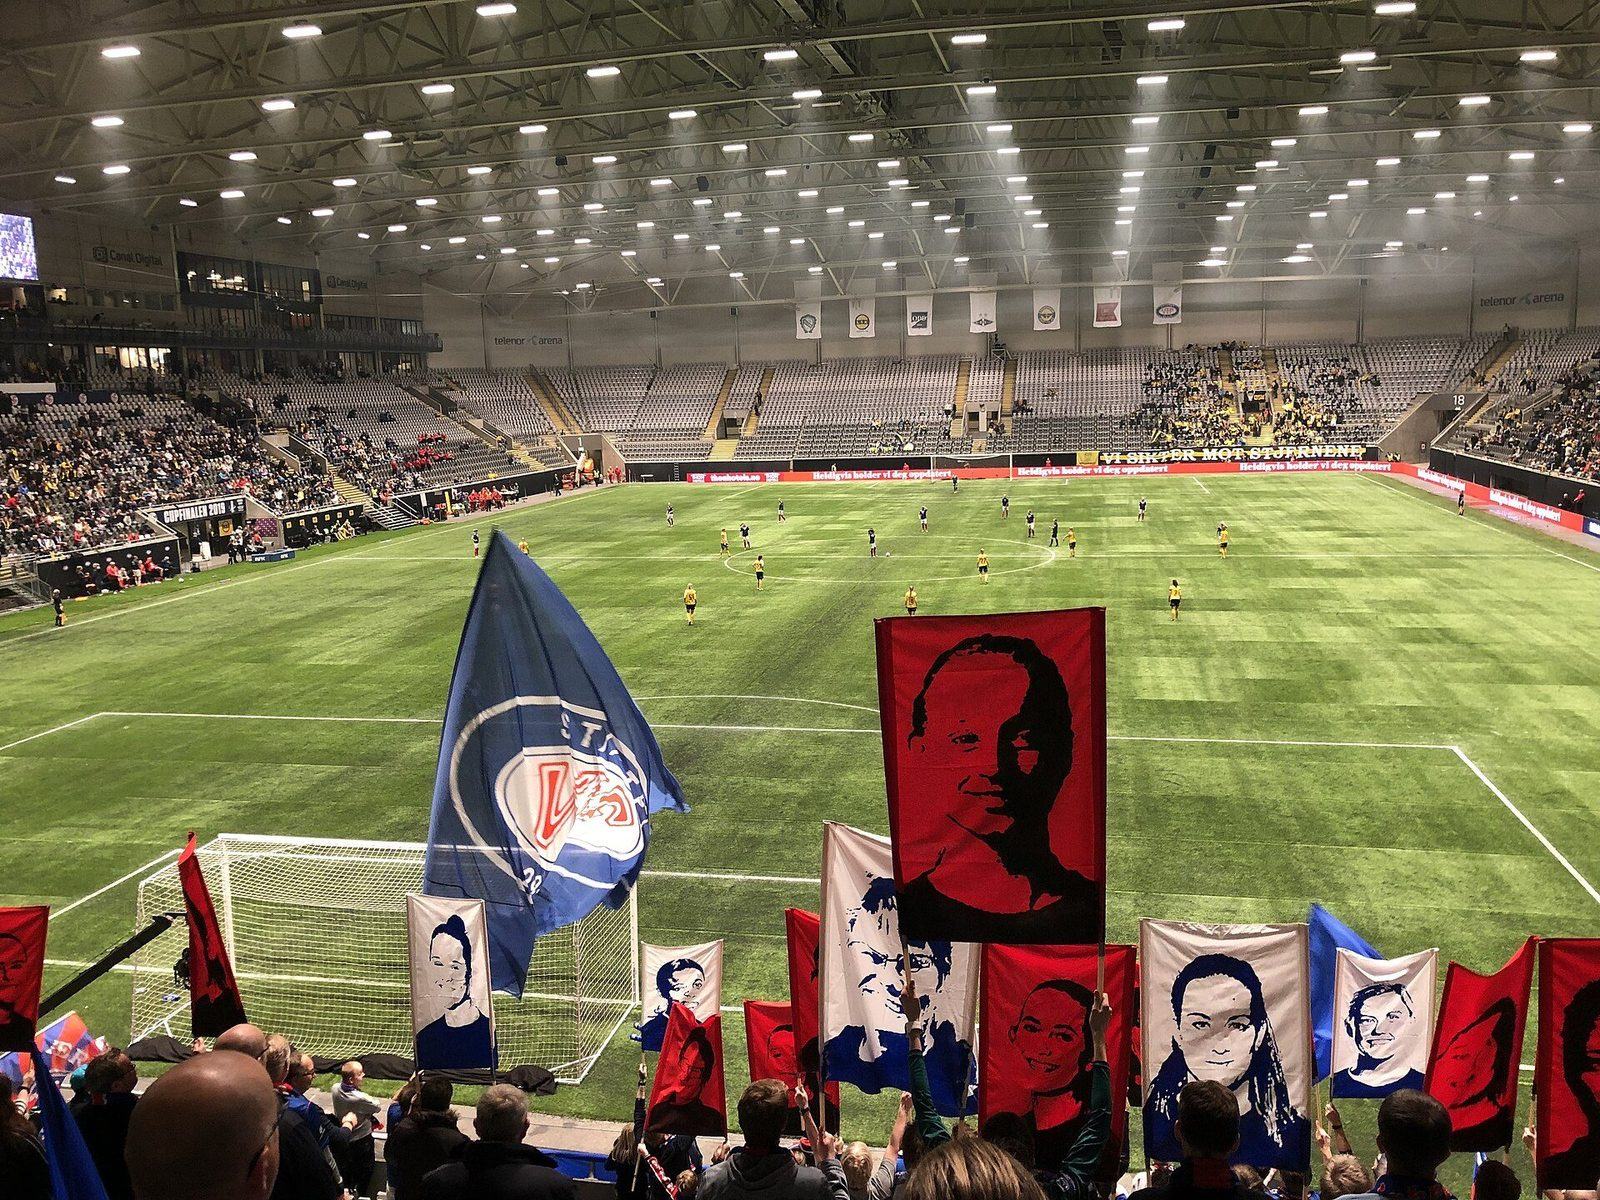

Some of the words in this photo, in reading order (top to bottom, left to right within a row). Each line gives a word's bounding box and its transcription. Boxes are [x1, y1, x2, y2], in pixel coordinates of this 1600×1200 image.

[1480, 296, 1517, 307] telenor
[1533, 292, 1564, 304] arena
[494, 336, 525, 345] telenor
[538, 336, 563, 345] arena
[1453, 394, 1465, 406] 18
[1102, 452, 1122, 464] VI
[1127, 448, 1196, 464] SIKTER
[1202, 447, 1244, 461] MOT
[1017, 467, 1060, 477] Heldigvis
[1061, 466, 1091, 475] holder
[1093, 465, 1102, 474] vi
[1103, 465, 1121, 475] deg
[1121, 465, 1169, 475] oppdatert
[1239, 462, 1285, 472] Heldigvis
[1286, 461, 1319, 470] holder
[1321, 461, 1330, 470] vi
[1331, 461, 1349, 471] deg
[1349, 462, 1392, 471] oppdatert
[812, 471, 852, 481] Heldigvis
[853, 471, 881, 479] holder
[892, 471, 908, 480] deg
[163, 505, 208, 524] CUPFINALEN
[208, 501, 226, 517] 2019
